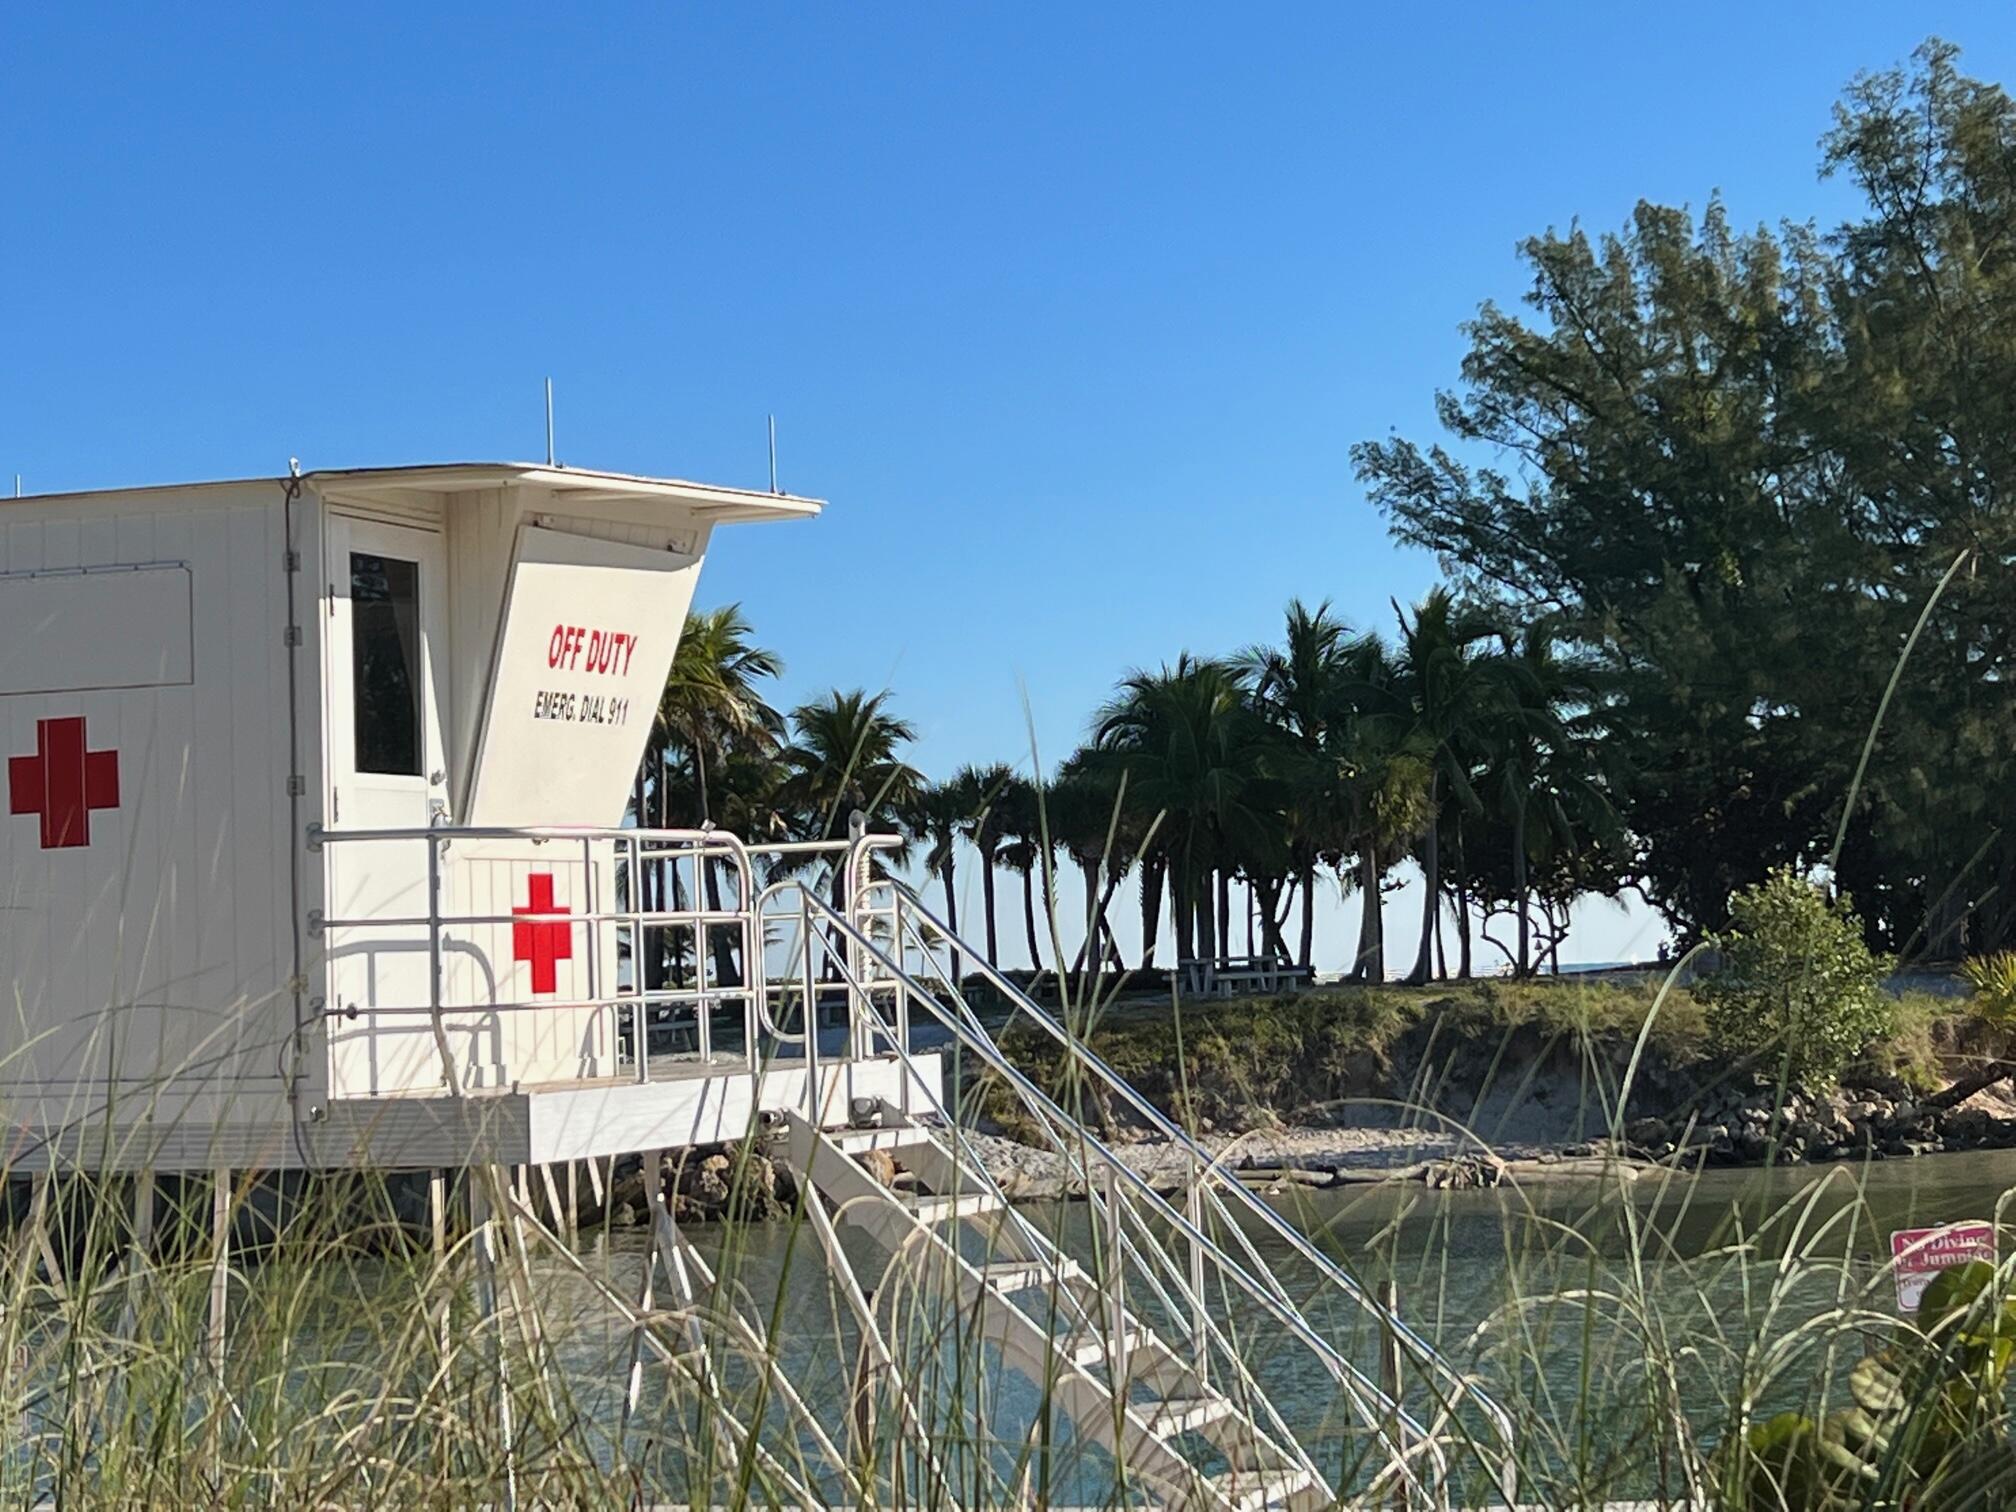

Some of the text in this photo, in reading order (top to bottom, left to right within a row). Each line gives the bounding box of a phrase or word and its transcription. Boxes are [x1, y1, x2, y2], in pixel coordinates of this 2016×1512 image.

[548, 623, 638, 676] OFF DUTY
[534, 690, 629, 725] EMERG. DIAL 911
